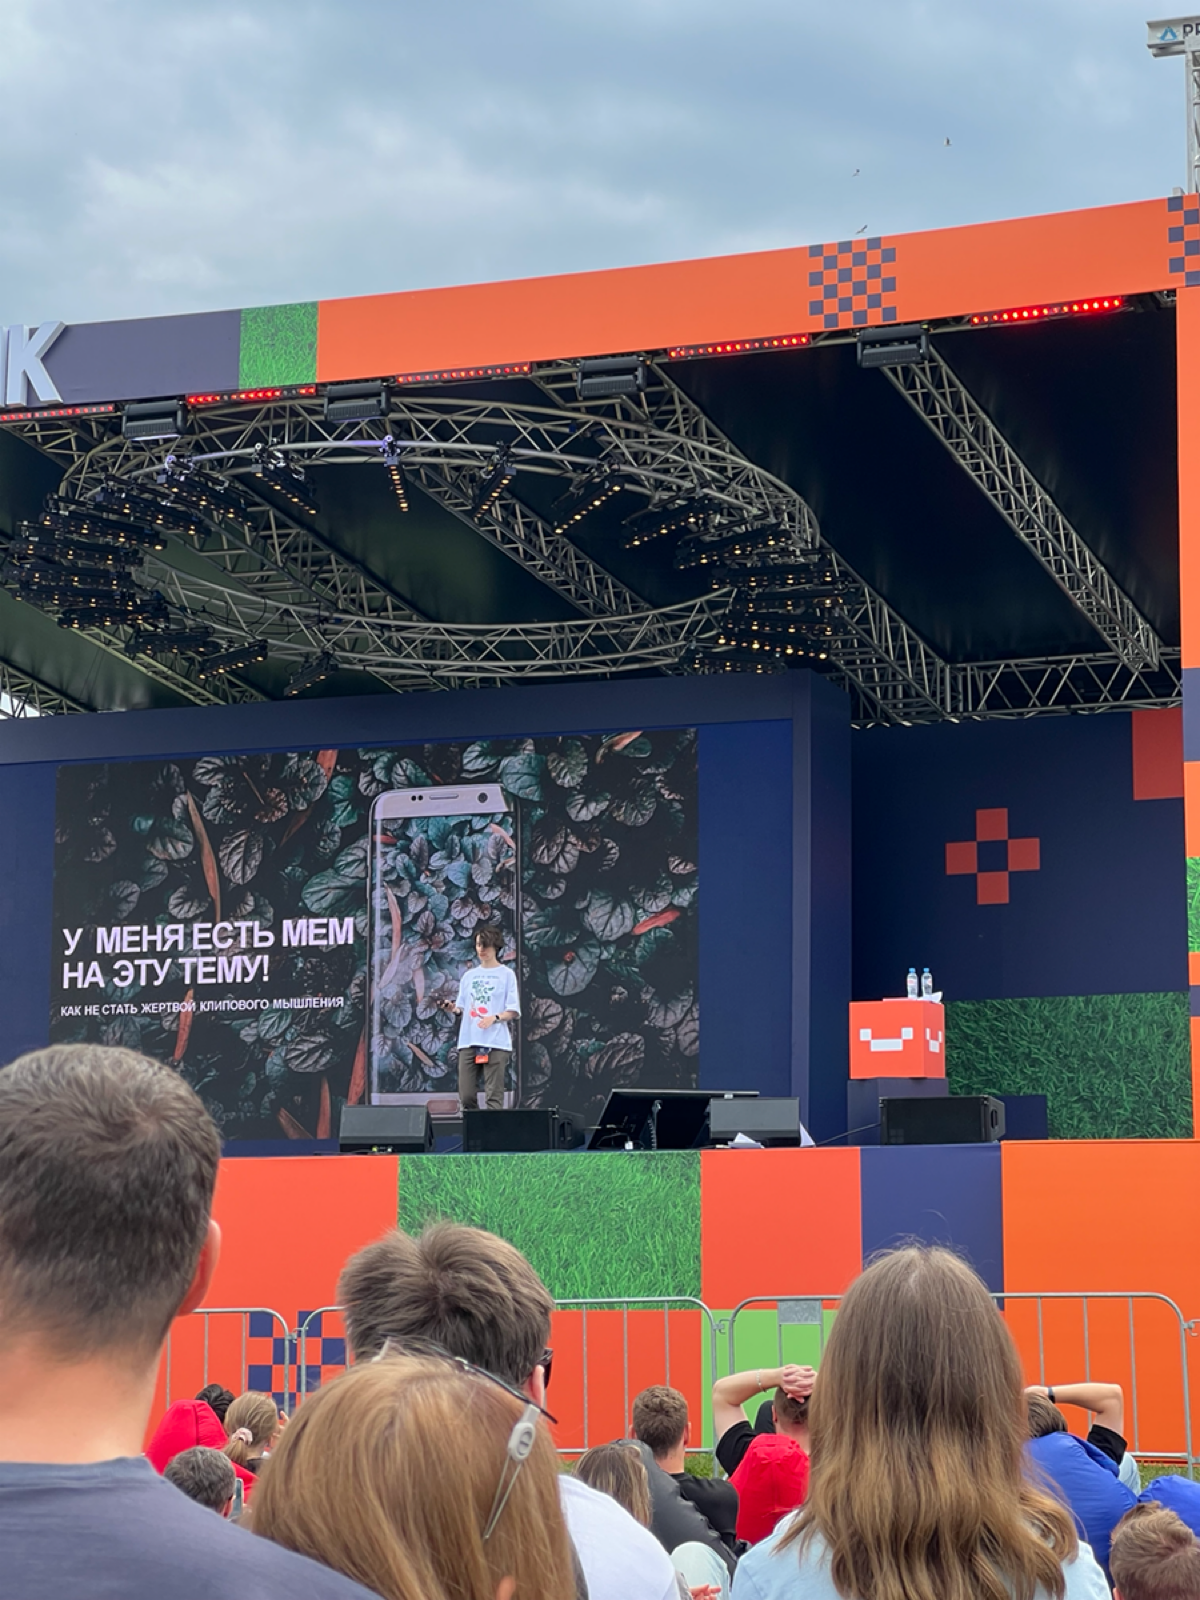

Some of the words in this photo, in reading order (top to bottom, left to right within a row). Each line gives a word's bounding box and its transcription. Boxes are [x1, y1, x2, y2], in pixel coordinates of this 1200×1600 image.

[62, 927, 83, 956] У
[96, 923, 184, 954] МЕНЯ
[192, 920, 275, 950] ЕСТЬ
[282, 917, 354, 947] МЕМ
[62, 961, 105, 988] НА
[112, 957, 172, 988] ЭТУ
[177, 955, 269, 984] ТЕМУ!
[60, 1005, 82, 1017] КАК
[84, 1004, 100, 1016] НЕ
[101, 1003, 138, 1015] СТАТЬ
[140, 1000, 196, 1013] ЖЕРТВОЙ
[199, 1000, 269, 1011] КЛИПОВОГО
[272, 997, 344, 1009] МЫШЛЕНИЯ
